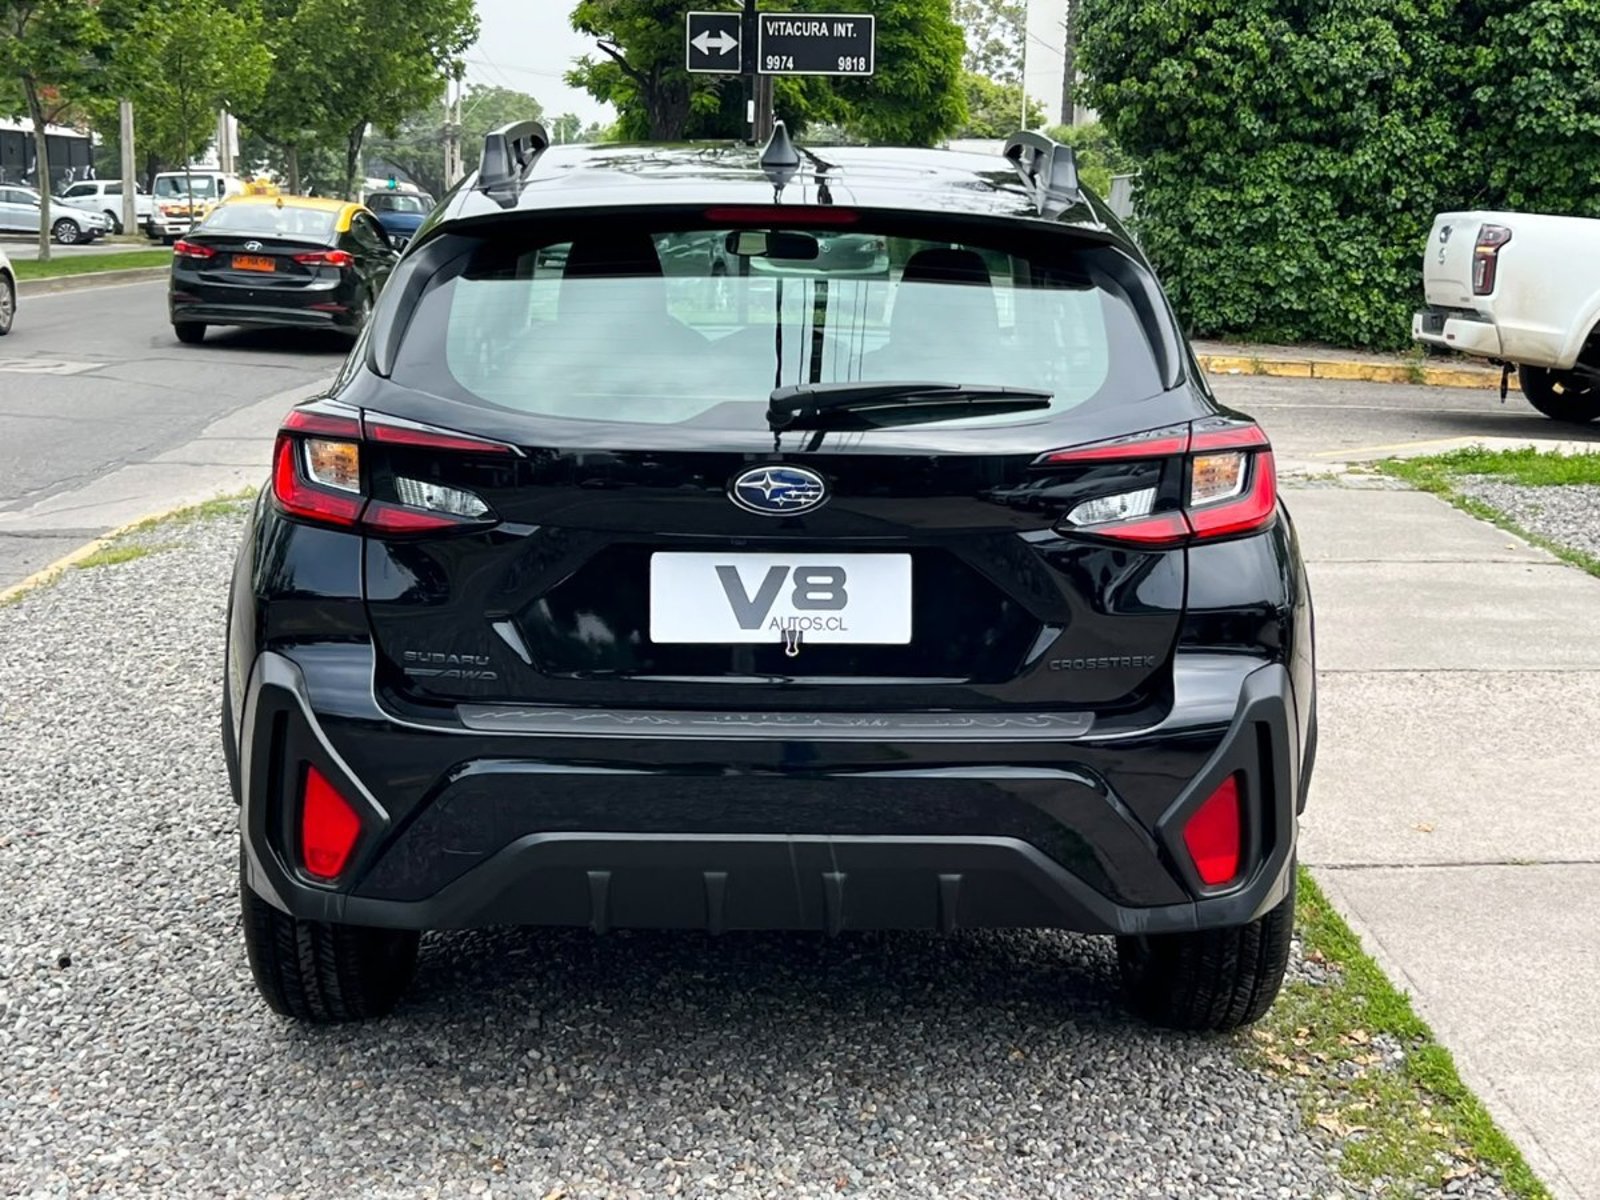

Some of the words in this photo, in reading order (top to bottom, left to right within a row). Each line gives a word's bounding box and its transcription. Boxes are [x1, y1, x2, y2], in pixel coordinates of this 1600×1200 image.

[766, 21, 829, 37] VITACURA
[833, 23, 857, 38] INT.
[766, 55, 794, 70] 9974
[837, 57, 866, 71] 9818
[714, 565, 848, 630] V8
[768, 616, 848, 631] AUTOS.CL
[403, 651, 490, 666] SUBARU
[1049, 655, 1156, 671] CROSSTREK
